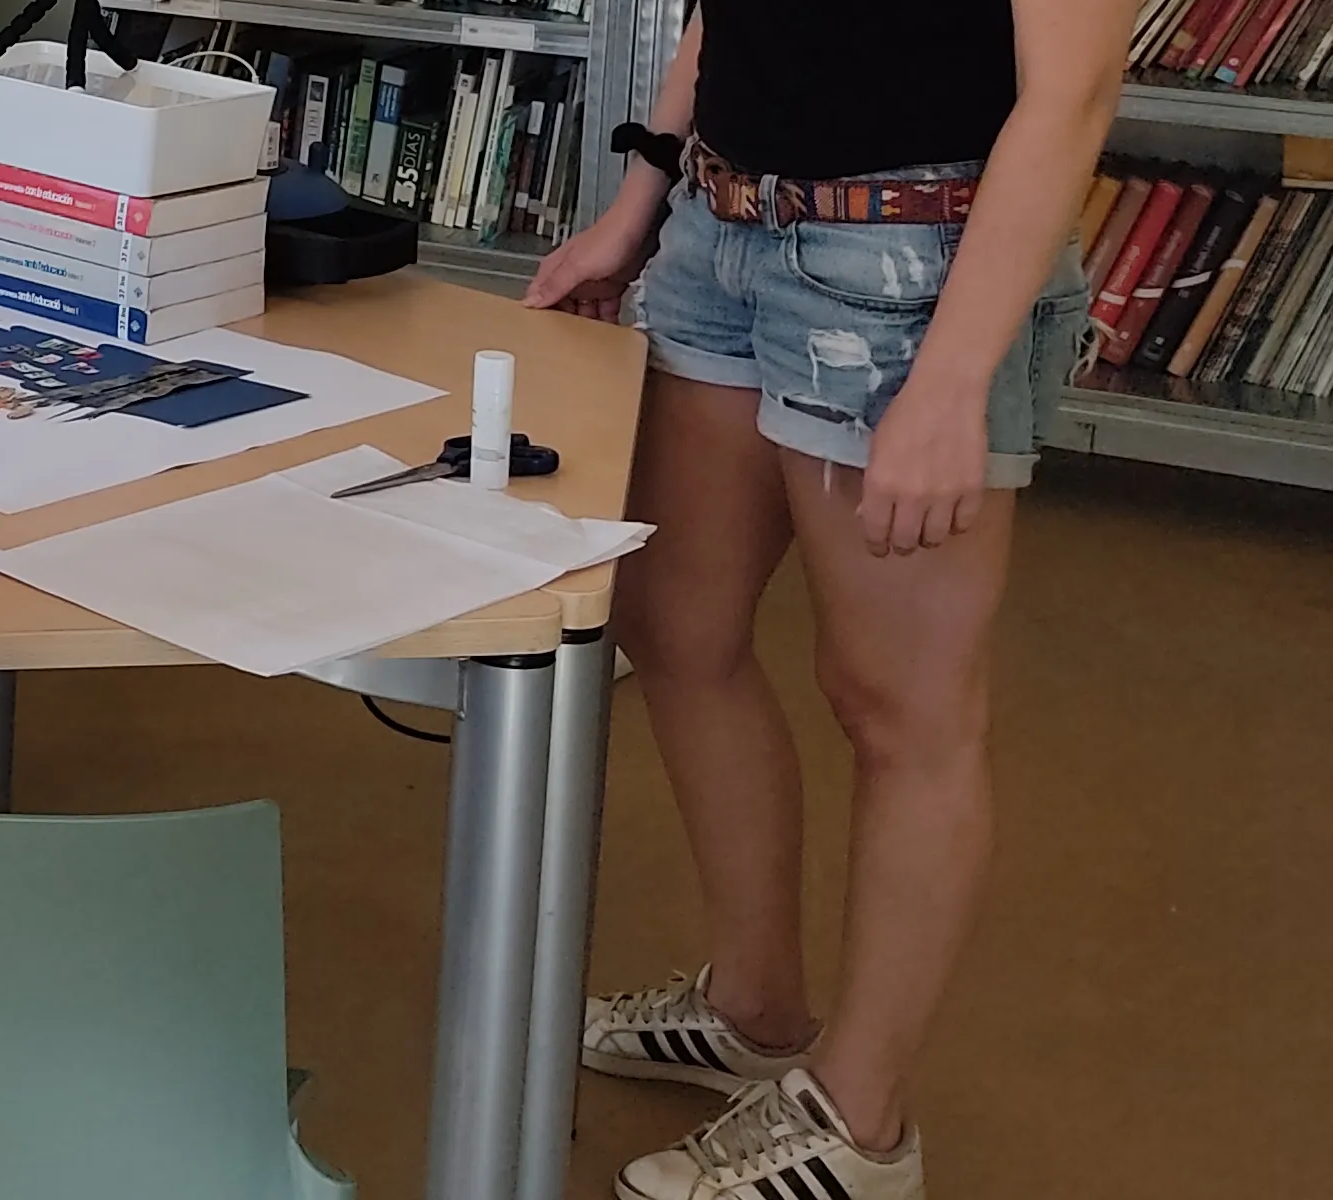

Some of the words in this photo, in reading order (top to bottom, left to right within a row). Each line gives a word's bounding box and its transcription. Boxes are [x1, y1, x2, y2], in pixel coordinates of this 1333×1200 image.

[120, 252, 127, 262] 37
[118, 289, 124, 298] 37
[119, 320, 125, 329] 37
